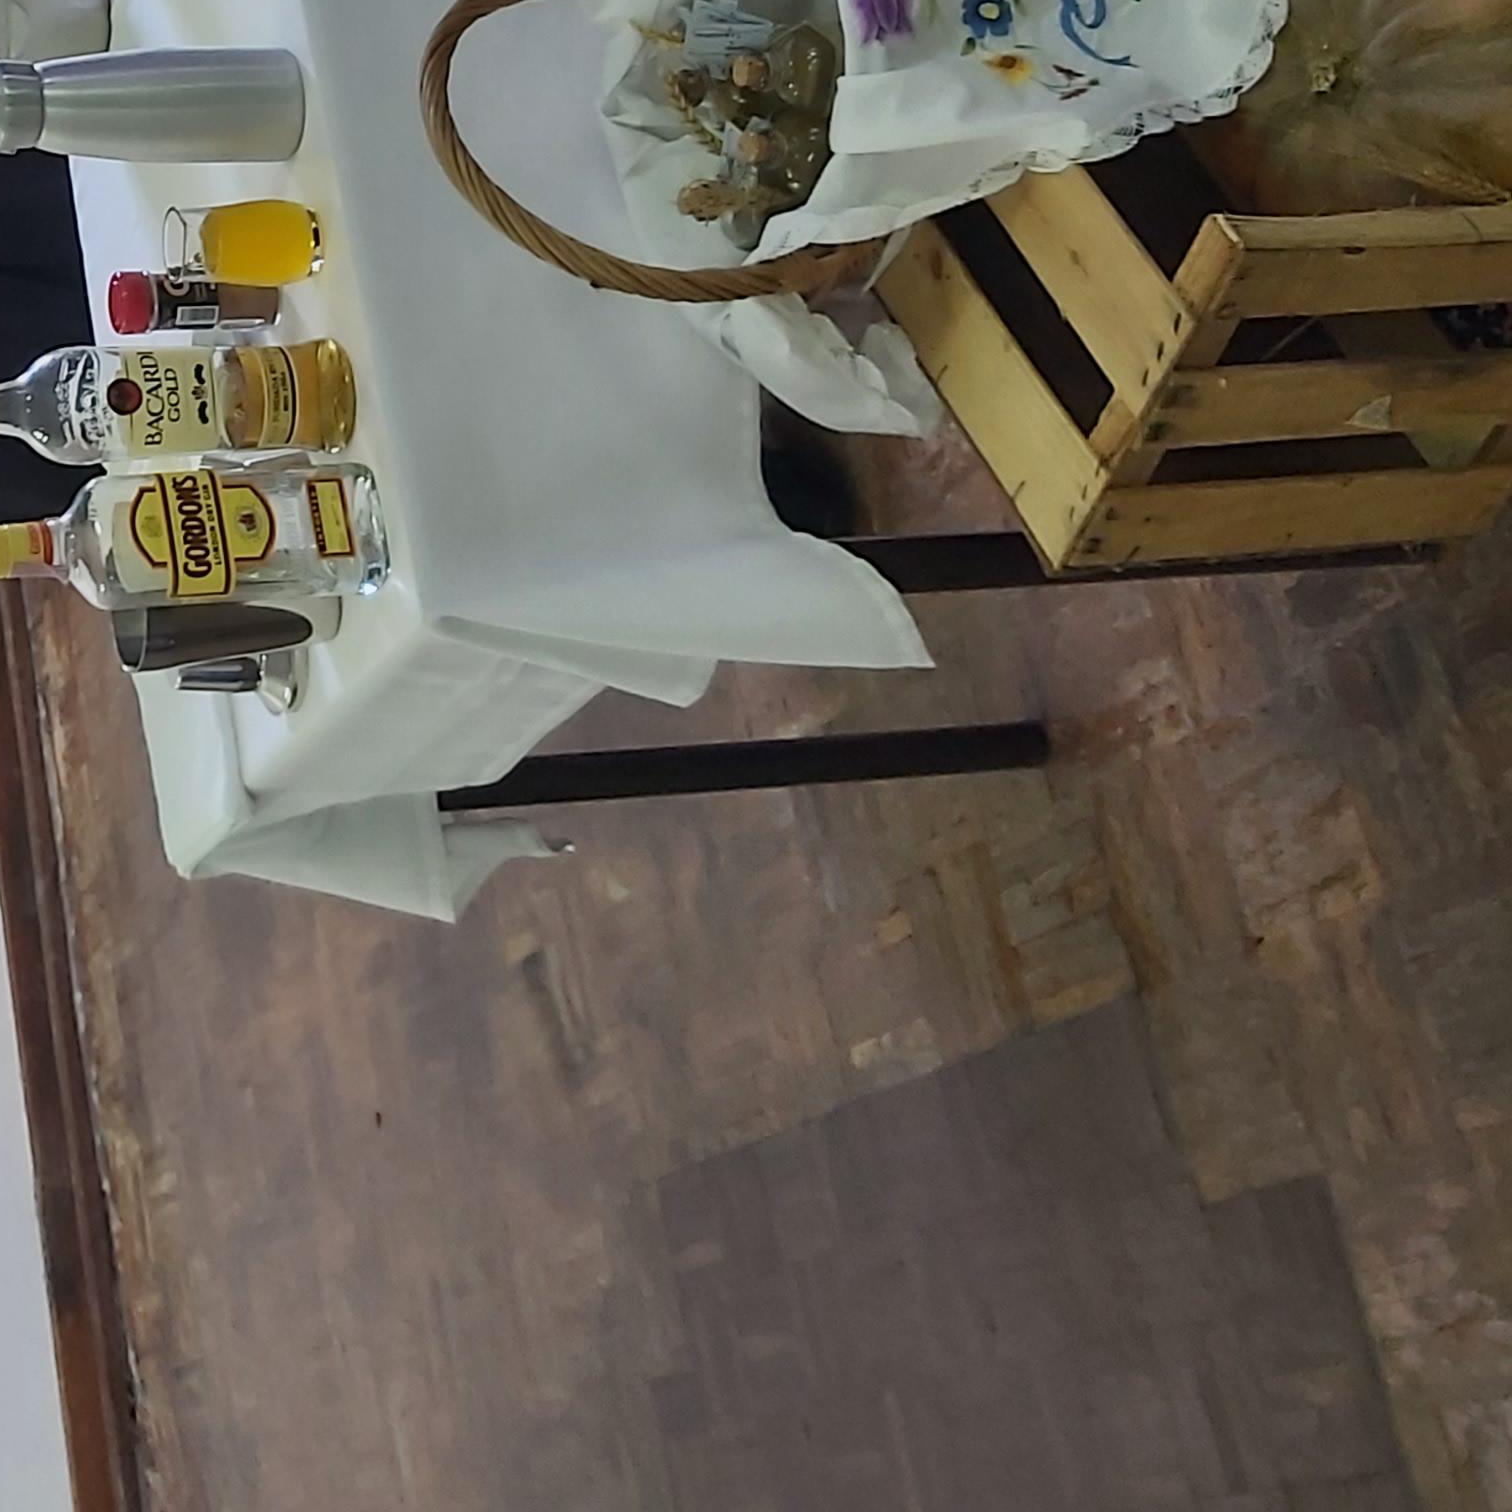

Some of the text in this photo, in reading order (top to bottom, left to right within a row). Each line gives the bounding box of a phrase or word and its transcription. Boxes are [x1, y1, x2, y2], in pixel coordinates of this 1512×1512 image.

[136, 351, 165, 446] BACARDI
[164, 367, 181, 423] GOLD
[171, 474, 213, 579] GORDON'S
